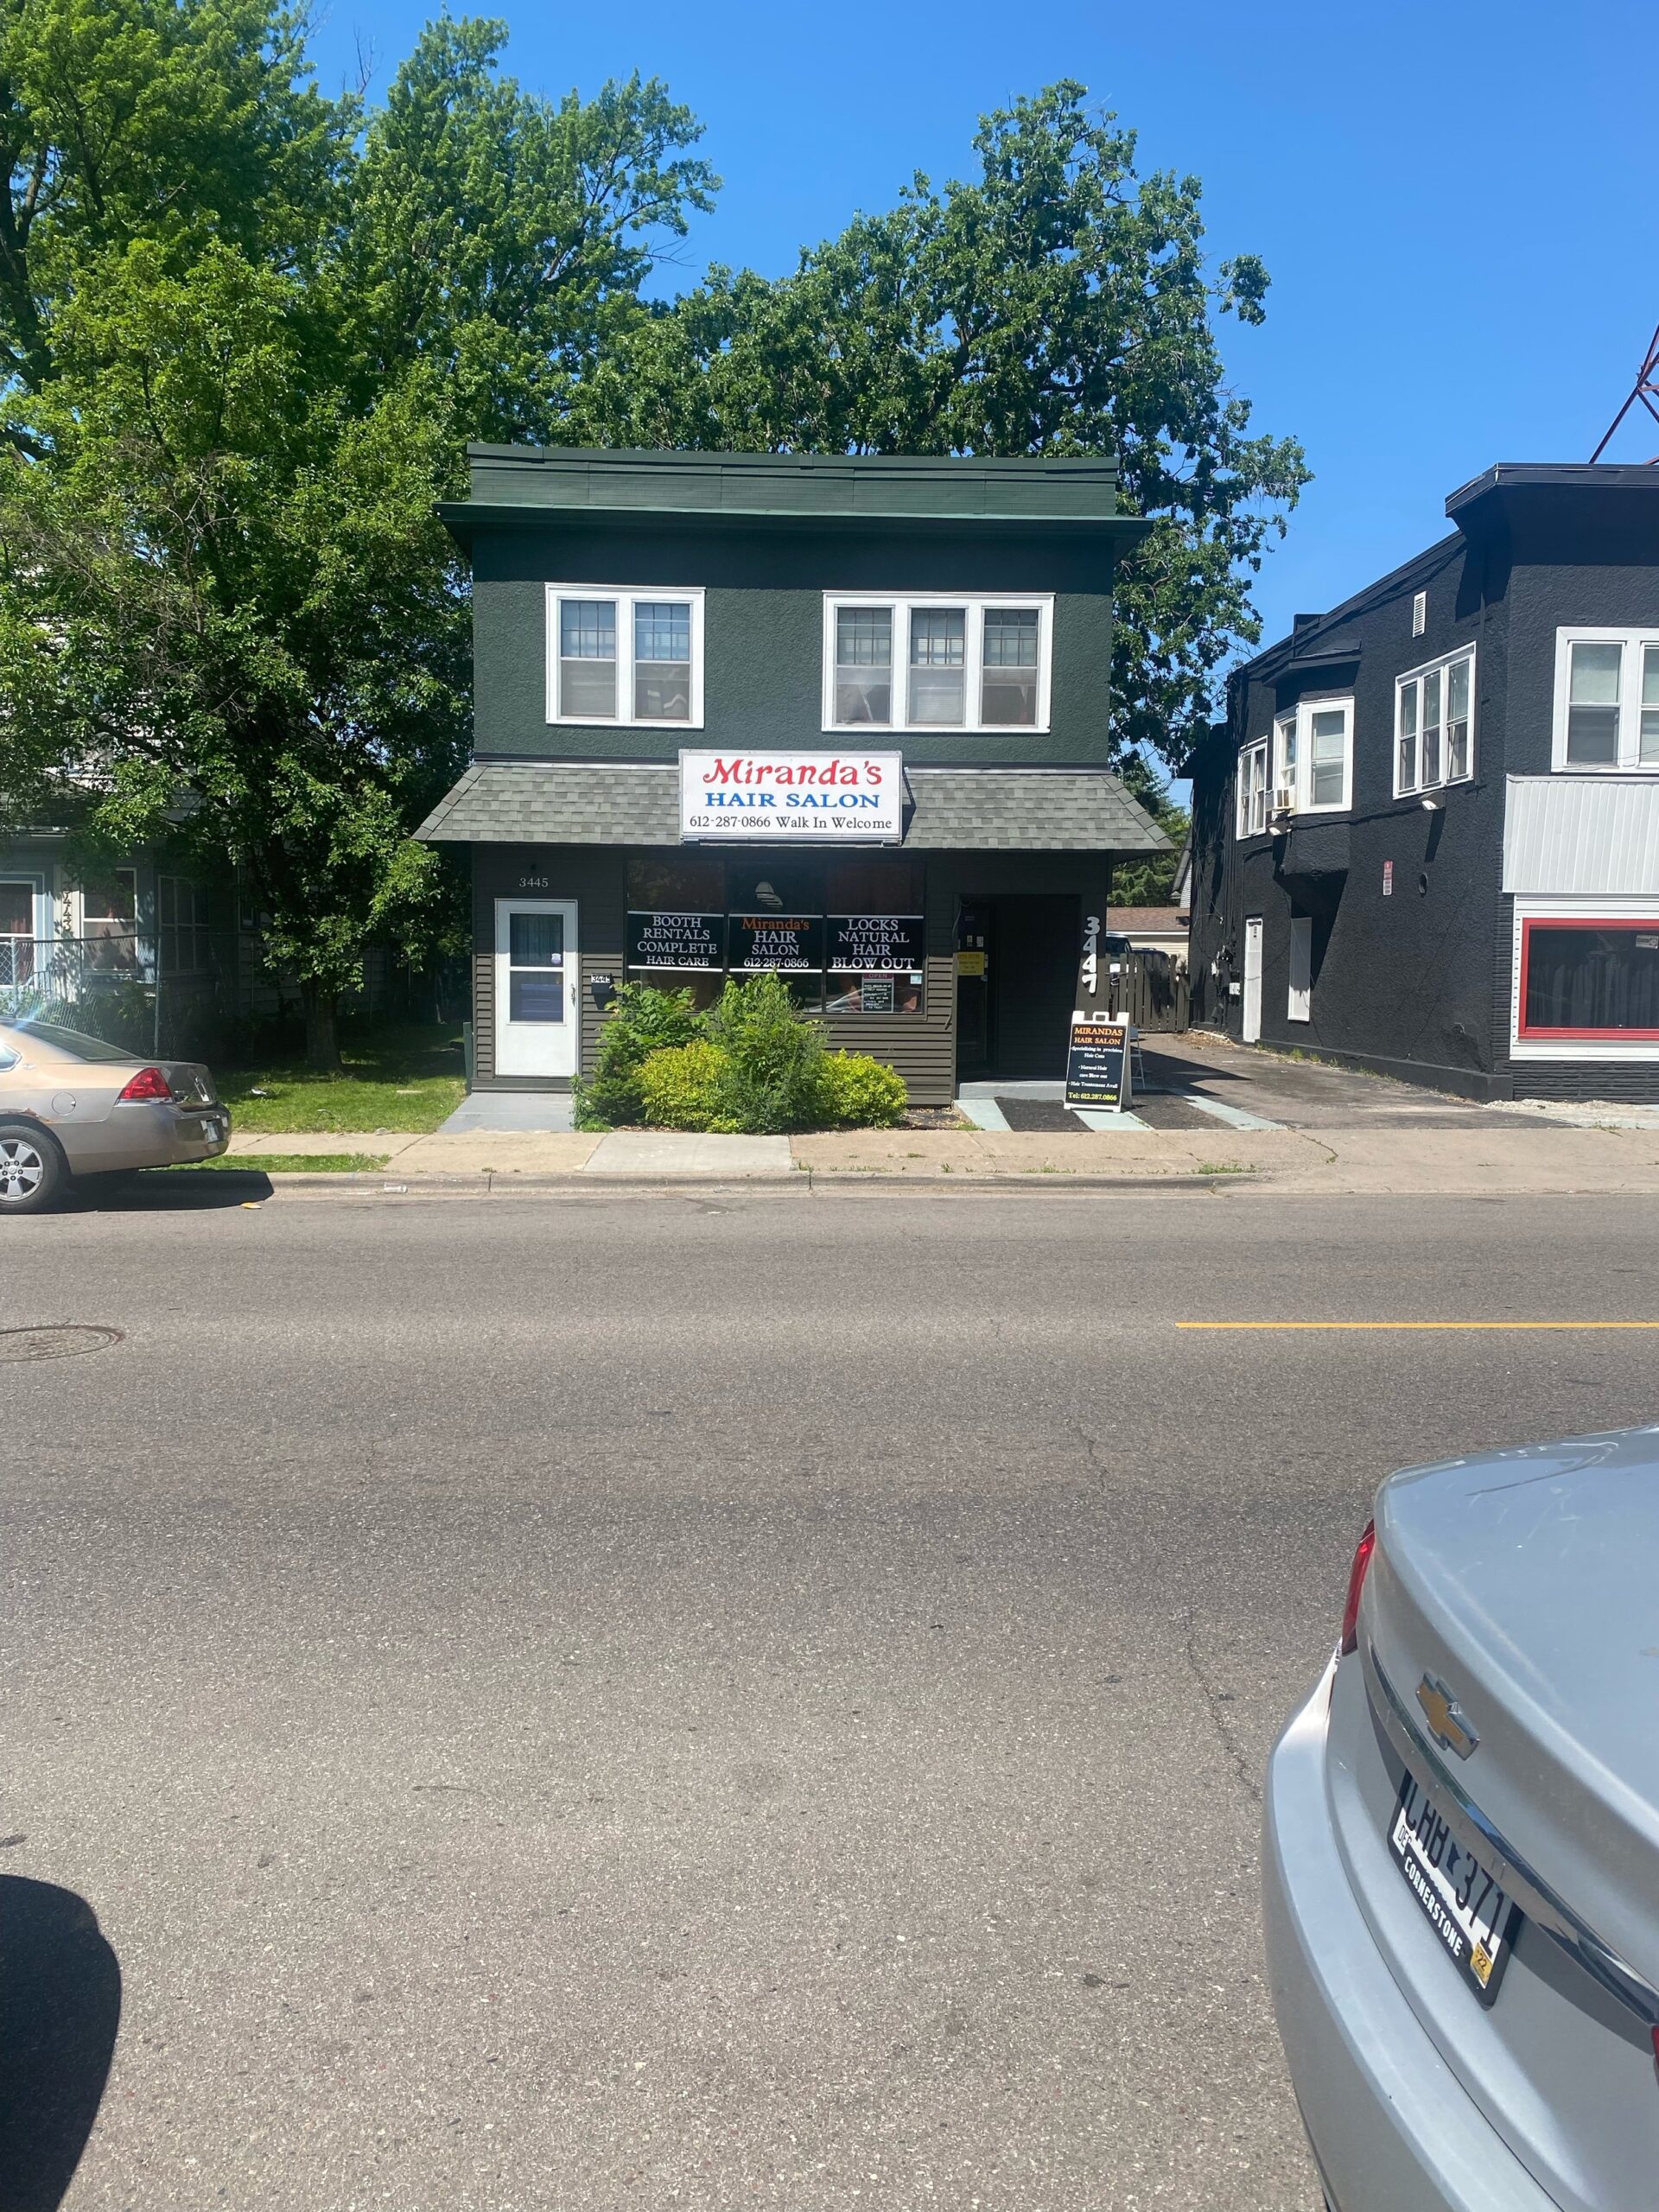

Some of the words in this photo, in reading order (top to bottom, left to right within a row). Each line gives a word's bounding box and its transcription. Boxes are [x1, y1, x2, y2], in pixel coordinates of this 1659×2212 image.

[702, 759, 882, 785] Miranda's
[705, 792, 777, 807] HAIR
[785, 793, 880, 809] SALON
[690, 816, 771, 828] 612-287-0866
[776, 816, 808, 829] Walk
[813, 817, 827, 829] In
[831, 817, 892, 830] Welcome
[518, 877, 549, 887] 3445
[652, 916, 702, 928] BOOTH
[741, 918, 810, 931] Miranda's
[848, 918, 899, 931] LOCKS
[643, 927, 710, 940] RENTALS
[753, 930, 798, 944] HAIR
[838, 931, 910, 943] NATURAL
[637, 941, 717, 955] COMPLETE
[751, 944, 800, 956] SALON
[852, 944, 892, 956] HAIR
[645, 956, 676, 965] HAIR
[678, 957, 709, 967] CARE
[1082, 916, 1100, 994] 3447
[831, 957, 877, 969] BLOW
[880, 958, 915, 969] OUT
[1074, 1027, 1123, 1037] MIRANDAS
[1404, 1856, 1463, 1957] CORNERSTONE
[1455, 1851, 1504, 1960] 371
